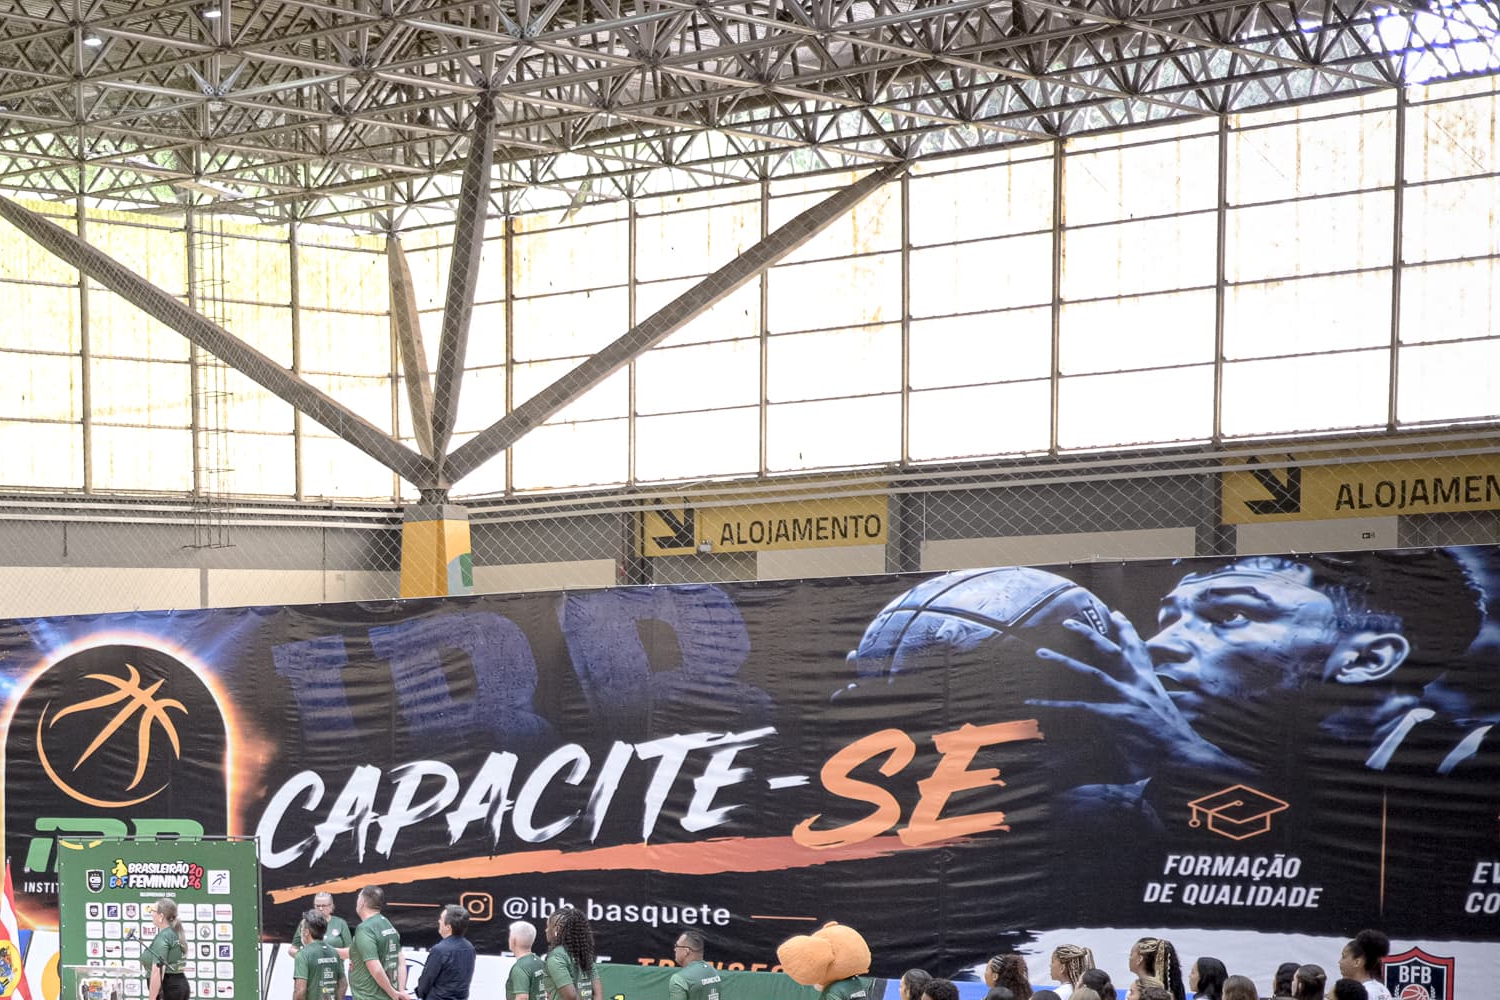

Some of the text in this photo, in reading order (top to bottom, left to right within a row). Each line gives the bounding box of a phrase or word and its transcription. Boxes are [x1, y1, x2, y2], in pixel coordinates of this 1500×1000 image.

[720, 514, 882, 546] ALOJAMENTO
[128, 860, 189, 874] BRASILEIRÃO
[1163, 853, 1302, 881] FORMAÇÃO
[128, 875, 189, 889] FEMININO
[1143, 882, 1323, 908] DE QUALIDADE
[1399, 965, 1432, 984] BFB
